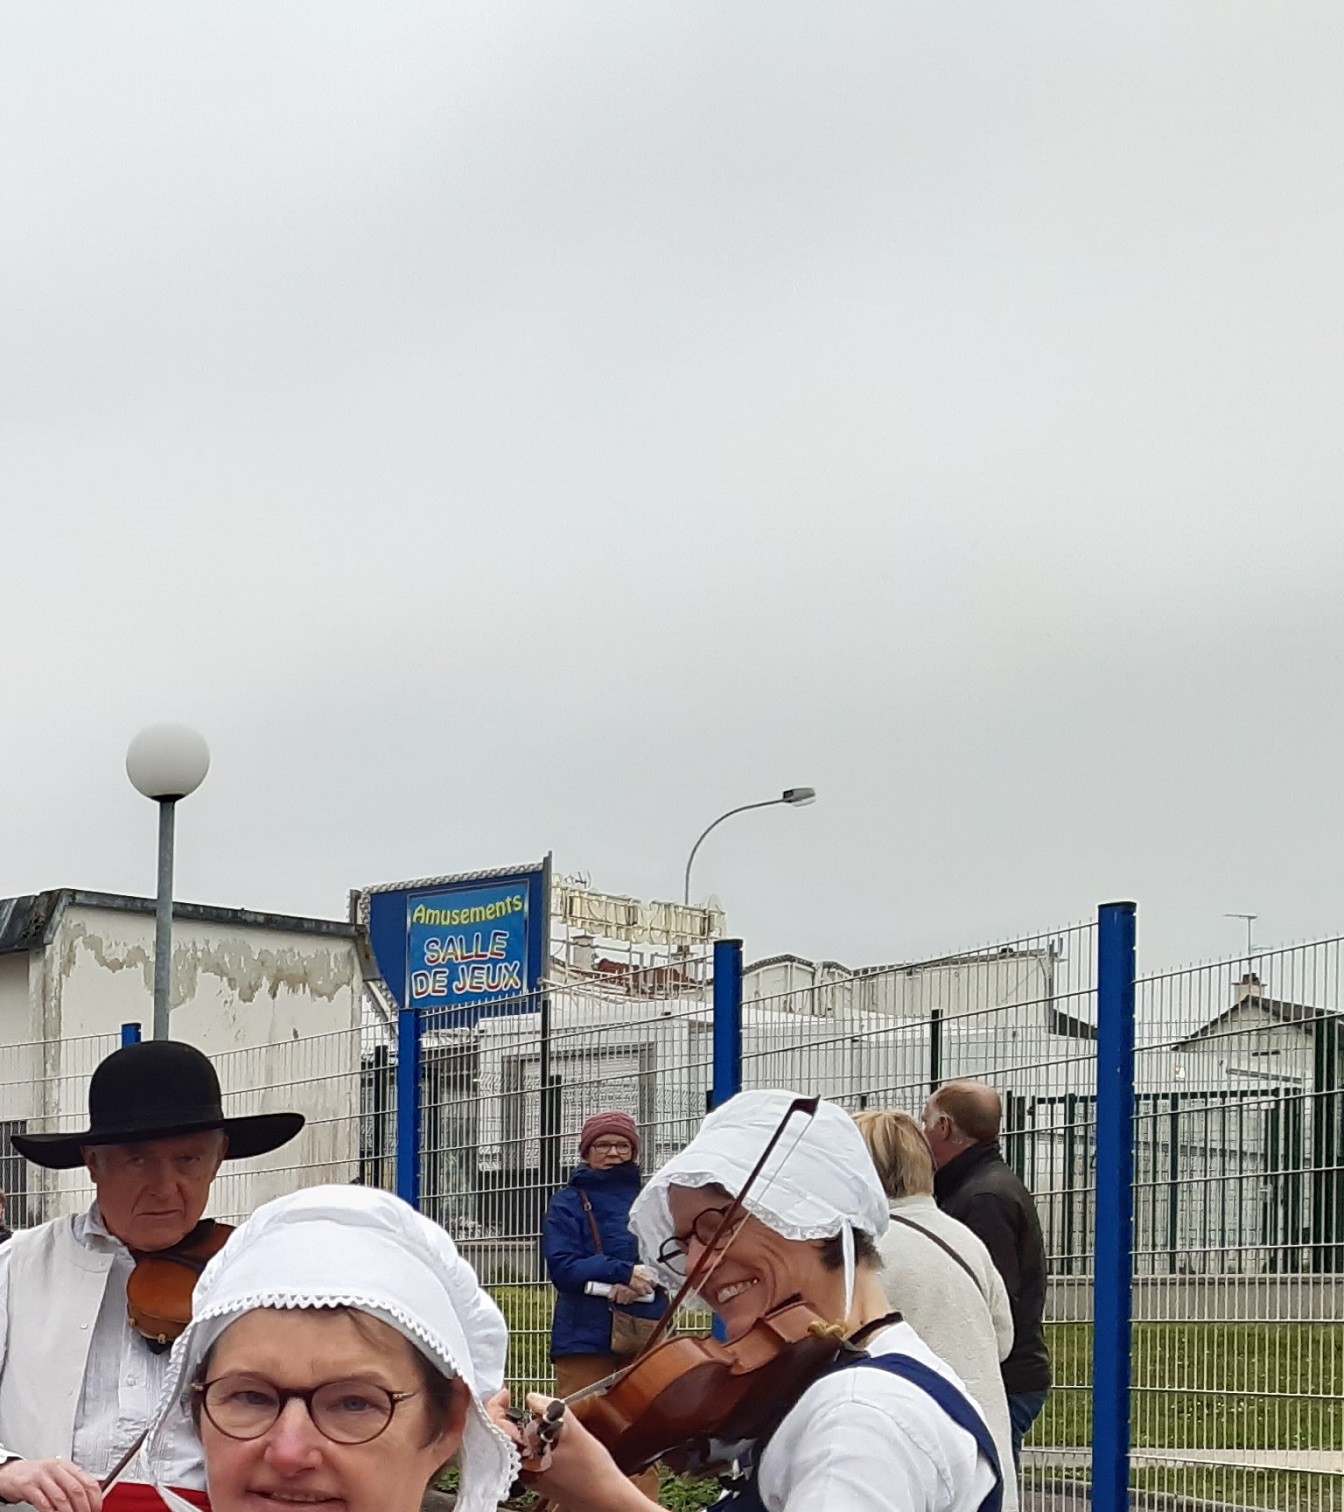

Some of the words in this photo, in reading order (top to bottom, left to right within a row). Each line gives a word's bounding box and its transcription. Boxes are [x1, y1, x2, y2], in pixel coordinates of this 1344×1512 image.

[412, 894, 523, 926] Amusements
[424, 930, 509, 965] SALLE
[412, 967, 449, 999] DE
[453, 960, 521, 994] JEUX
